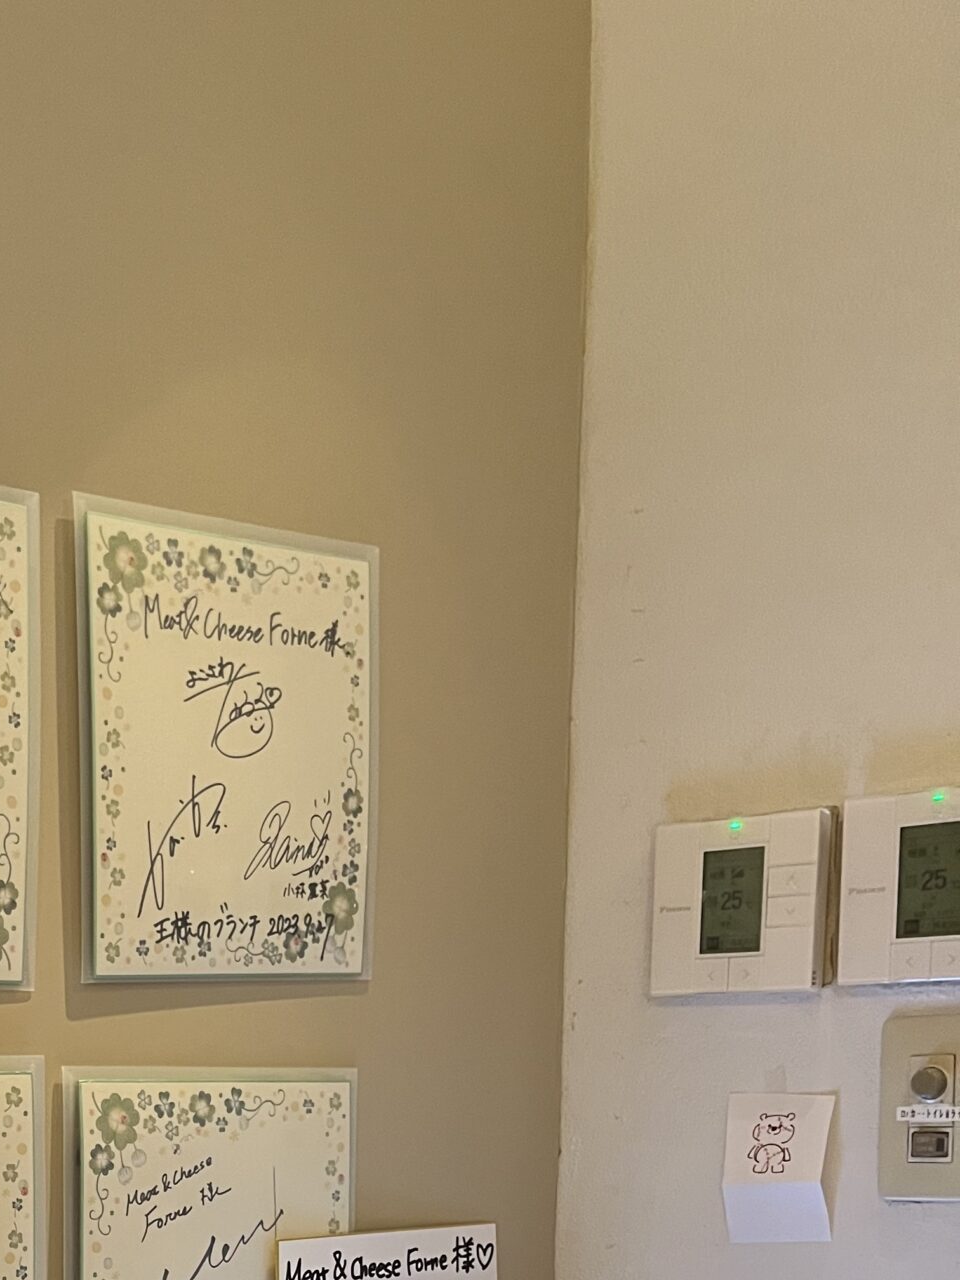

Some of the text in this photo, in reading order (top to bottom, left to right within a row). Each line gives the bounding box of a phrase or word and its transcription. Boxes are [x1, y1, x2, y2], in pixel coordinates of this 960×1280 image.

[920, 868, 948, 892] 25
[720, 890, 744, 911] 25
[153, 902, 261, 946] 王様のブランチ
[350, 1256, 402, 1280] Cheese
